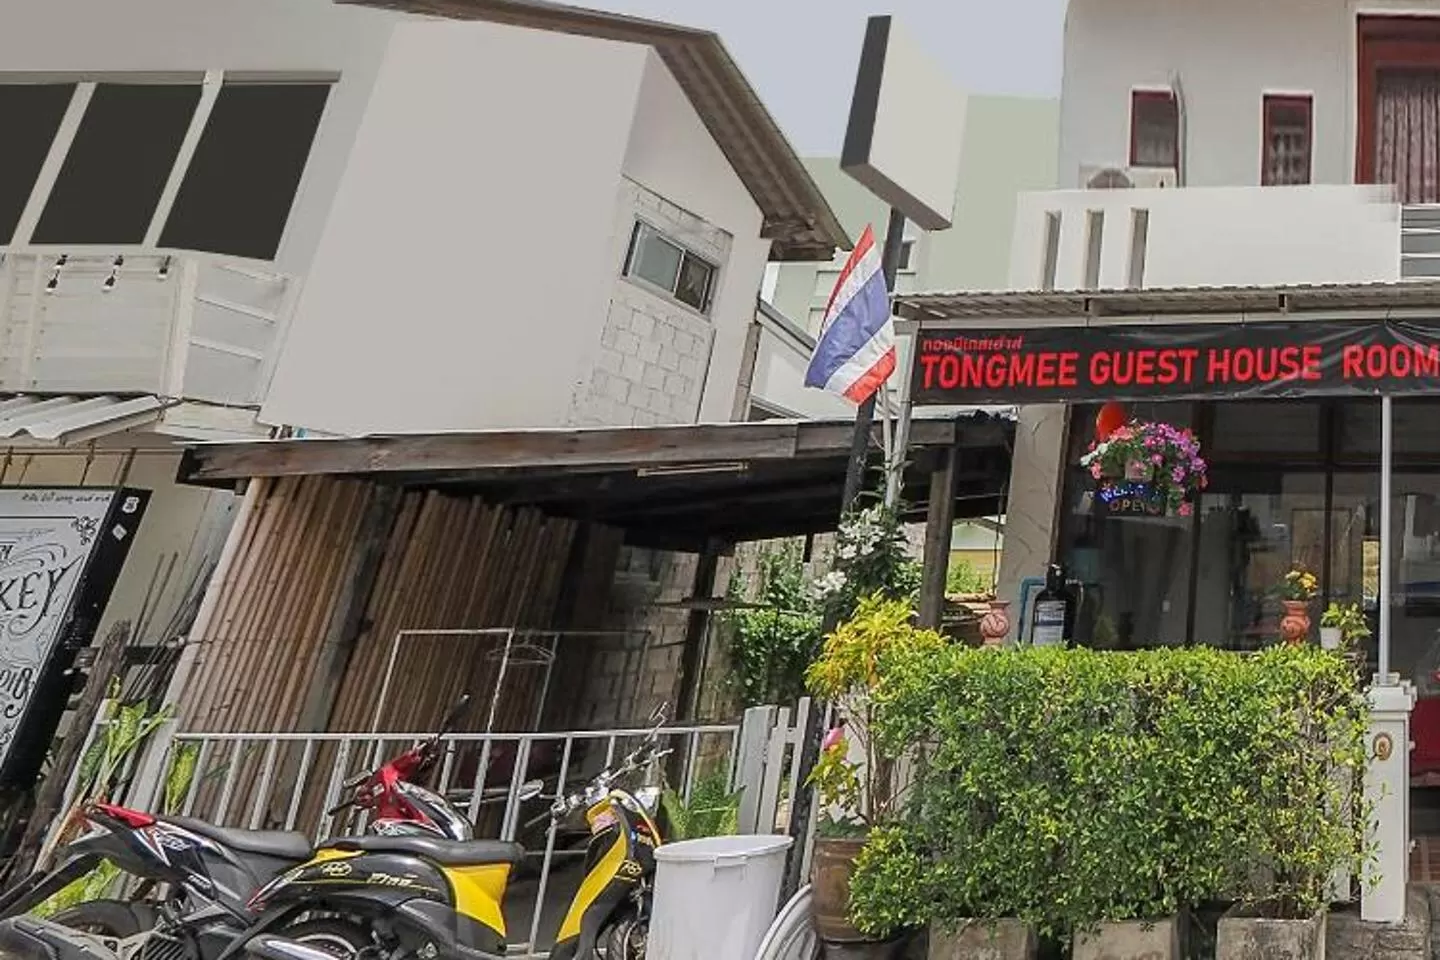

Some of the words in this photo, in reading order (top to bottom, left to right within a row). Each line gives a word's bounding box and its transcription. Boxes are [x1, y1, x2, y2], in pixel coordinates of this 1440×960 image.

[920, 352, 1079, 389] TONGMEE
[1089, 349, 1199, 384] GUEST
[1207, 345, 1323, 383] HOUSE
[1343, 343, 1439, 378] ROOM
